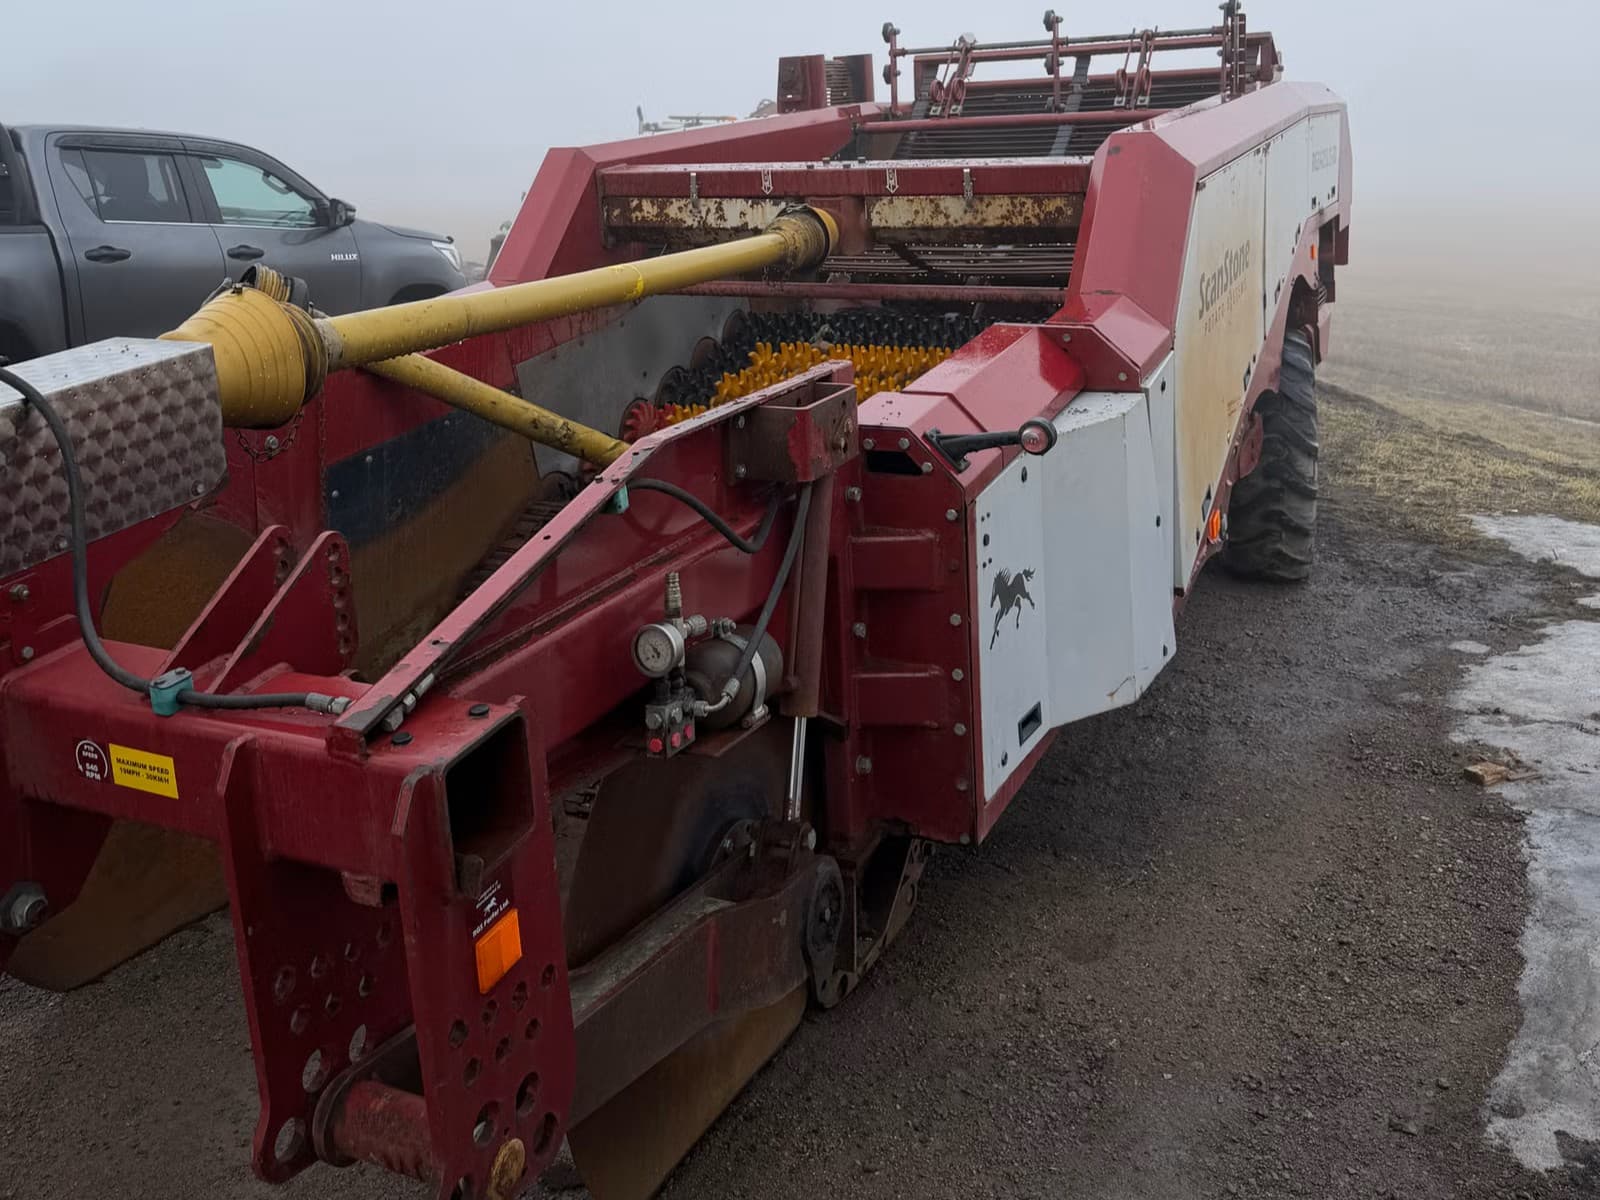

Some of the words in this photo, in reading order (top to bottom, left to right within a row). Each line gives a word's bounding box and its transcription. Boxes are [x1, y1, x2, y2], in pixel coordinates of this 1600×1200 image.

[330, 253, 358, 261] HILUX
[1199, 239, 1250, 320] ScanStone
[84, 744, 95, 752] PTO
[82, 750, 98, 760] SPEED
[85, 762, 98, 772] 540
[116, 757, 147, 770] MAXIMUM
[148, 763, 170, 775] SPEED
[85, 770, 101, 780] RPM
[119, 767, 140, 777] 19MPH
